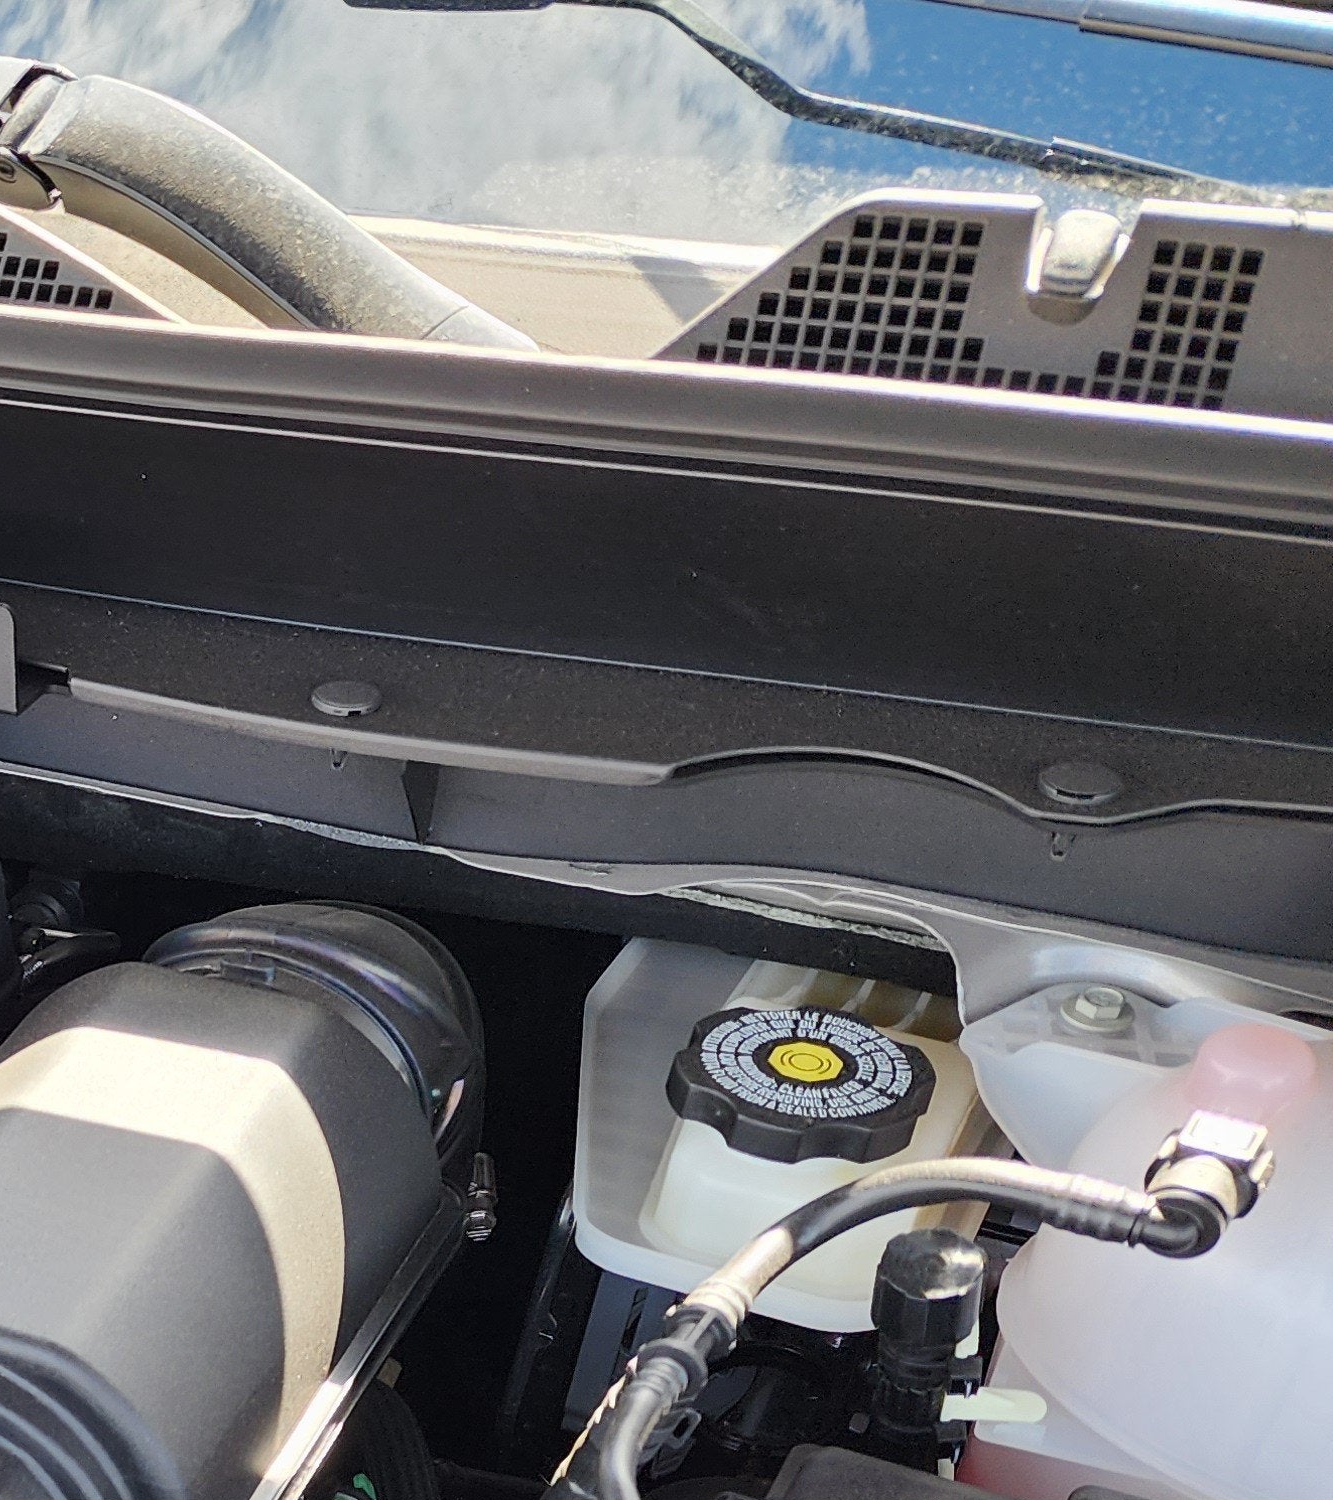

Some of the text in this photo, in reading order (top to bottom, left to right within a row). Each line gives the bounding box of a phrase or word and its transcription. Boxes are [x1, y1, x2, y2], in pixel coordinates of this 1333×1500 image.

[766, 1018, 795, 1028] QUE
[798, 1018, 817, 1028] DU
[774, 1084, 824, 1099] CLEAN
[821, 1080, 868, 1099] FILLER
[763, 1100, 778, 1110] A
[774, 1103, 828, 1117] SEALED
[827, 1096, 856, 1108] USE
